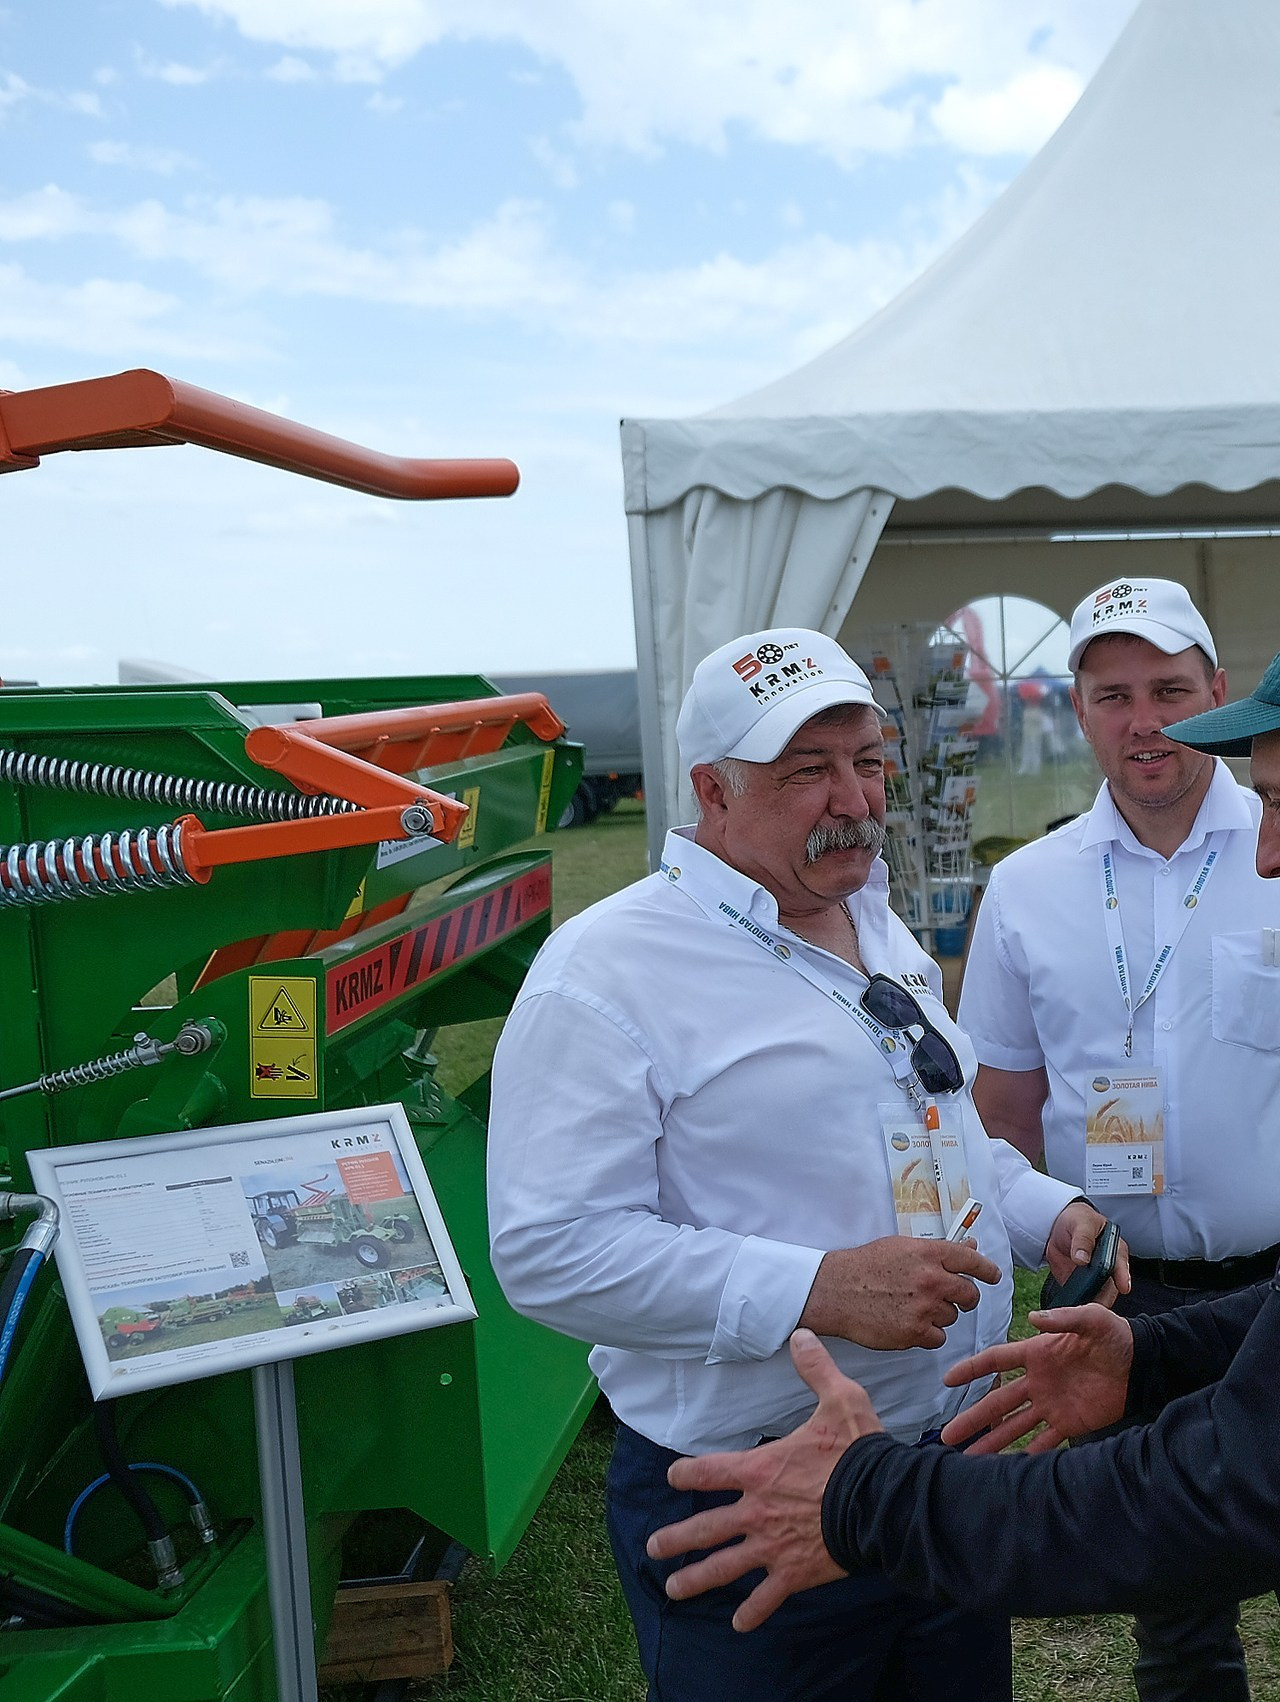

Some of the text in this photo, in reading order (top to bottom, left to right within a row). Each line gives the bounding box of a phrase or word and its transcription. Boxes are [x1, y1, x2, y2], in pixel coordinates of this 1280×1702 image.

[1093, 600, 1147, 621] KRMZ
[749, 658, 817, 698] KRMZ
[718, 901, 774, 946] ЗОЛОТАЯ НИВА
[1144, 945, 1172, 993] ЗОЛОТАЯ НИВА
[336, 960, 383, 1015] KRMZ
[832, 990, 852, 1008] НИВА
[852, 1007, 883, 1037] ЗОЛОТАЯ
[331, 1133, 381, 1149] KRMZ
[912, 1140, 931, 1148] ЗОЛО
